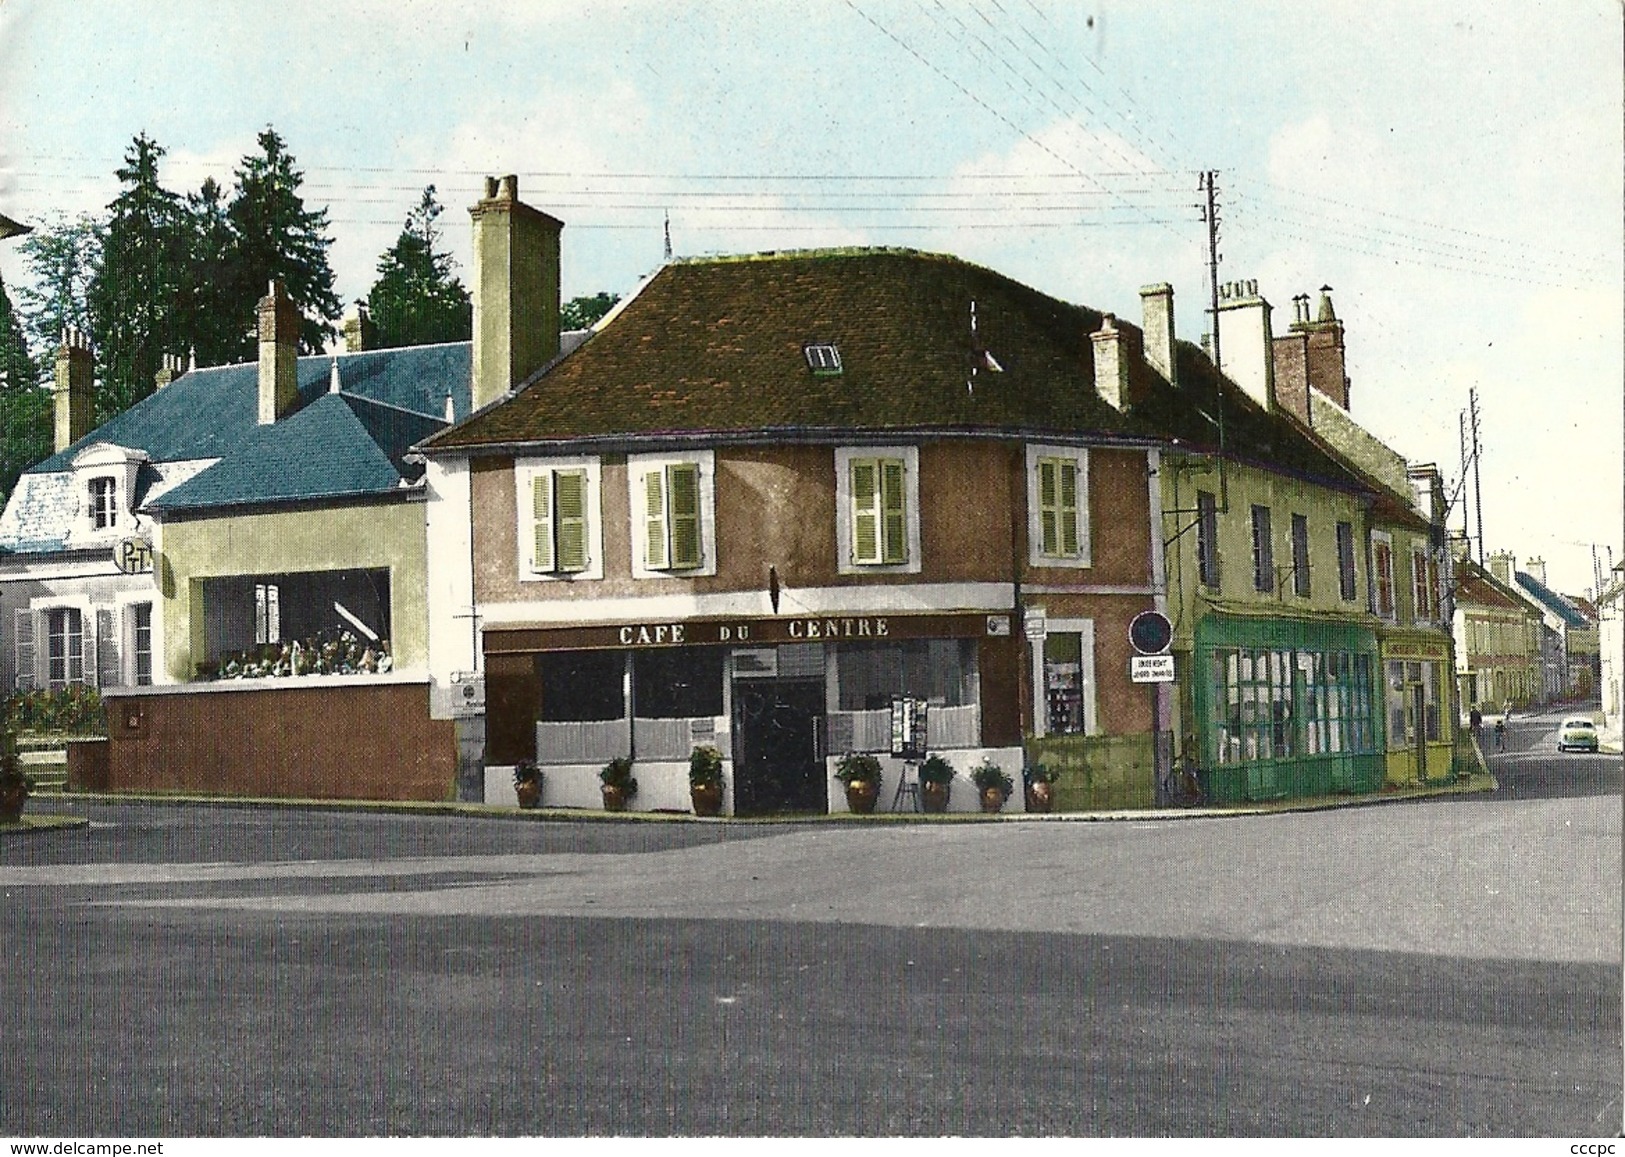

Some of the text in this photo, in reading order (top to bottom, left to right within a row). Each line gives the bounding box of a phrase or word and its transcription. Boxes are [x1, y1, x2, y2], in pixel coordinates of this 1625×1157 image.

[123, 541, 148, 574] PTT
[619, 618, 889, 644] CAFE DU CENTRE
